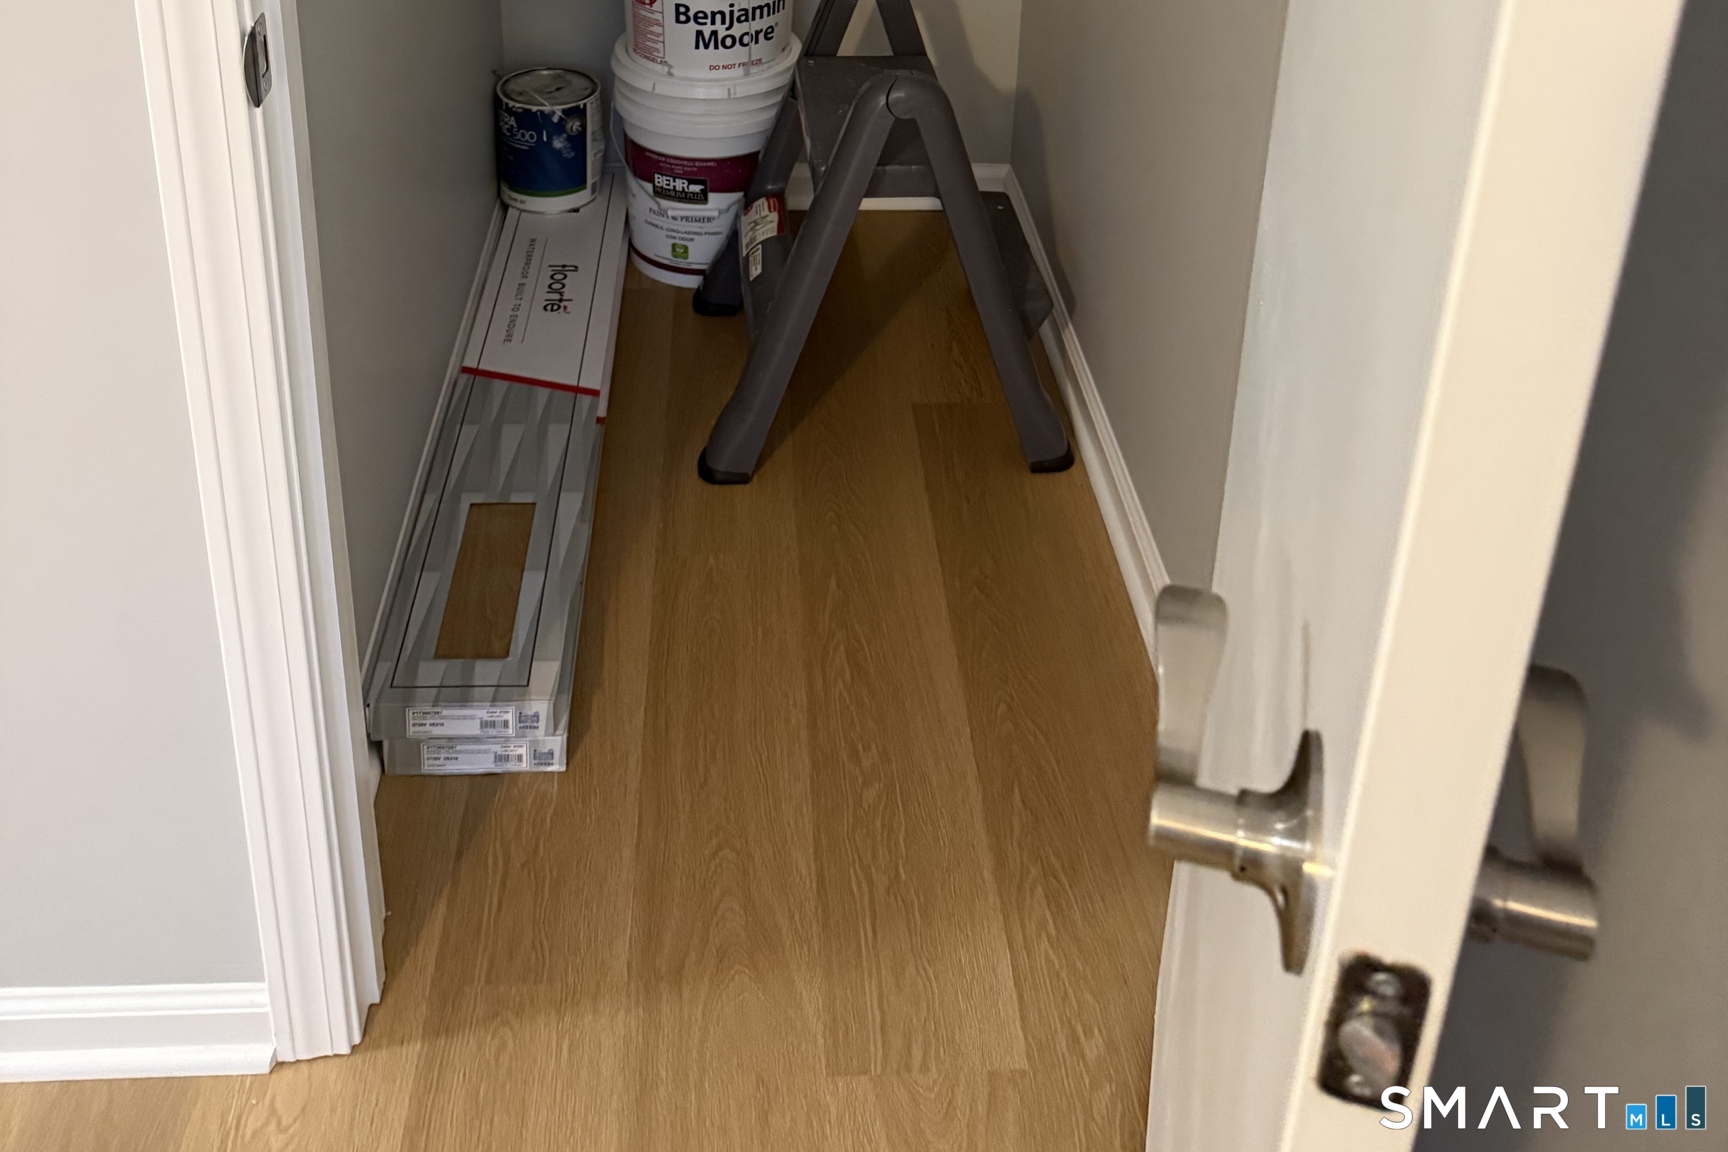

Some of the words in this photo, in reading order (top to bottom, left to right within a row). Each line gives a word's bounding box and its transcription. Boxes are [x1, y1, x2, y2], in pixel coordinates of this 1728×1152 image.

[694, 23, 775, 51] Moore
[738, 58, 763, 68] FREZE
[513, 128, 537, 143] 500
[654, 173, 689, 192] BEHR
[654, 187, 686, 198] PREMIUM
[686, 192, 705, 200] PLUS
[521, 237, 537, 280] WATERPROOF
[514, 282, 527, 303] BUILT
[512, 303, 522, 313] TO
